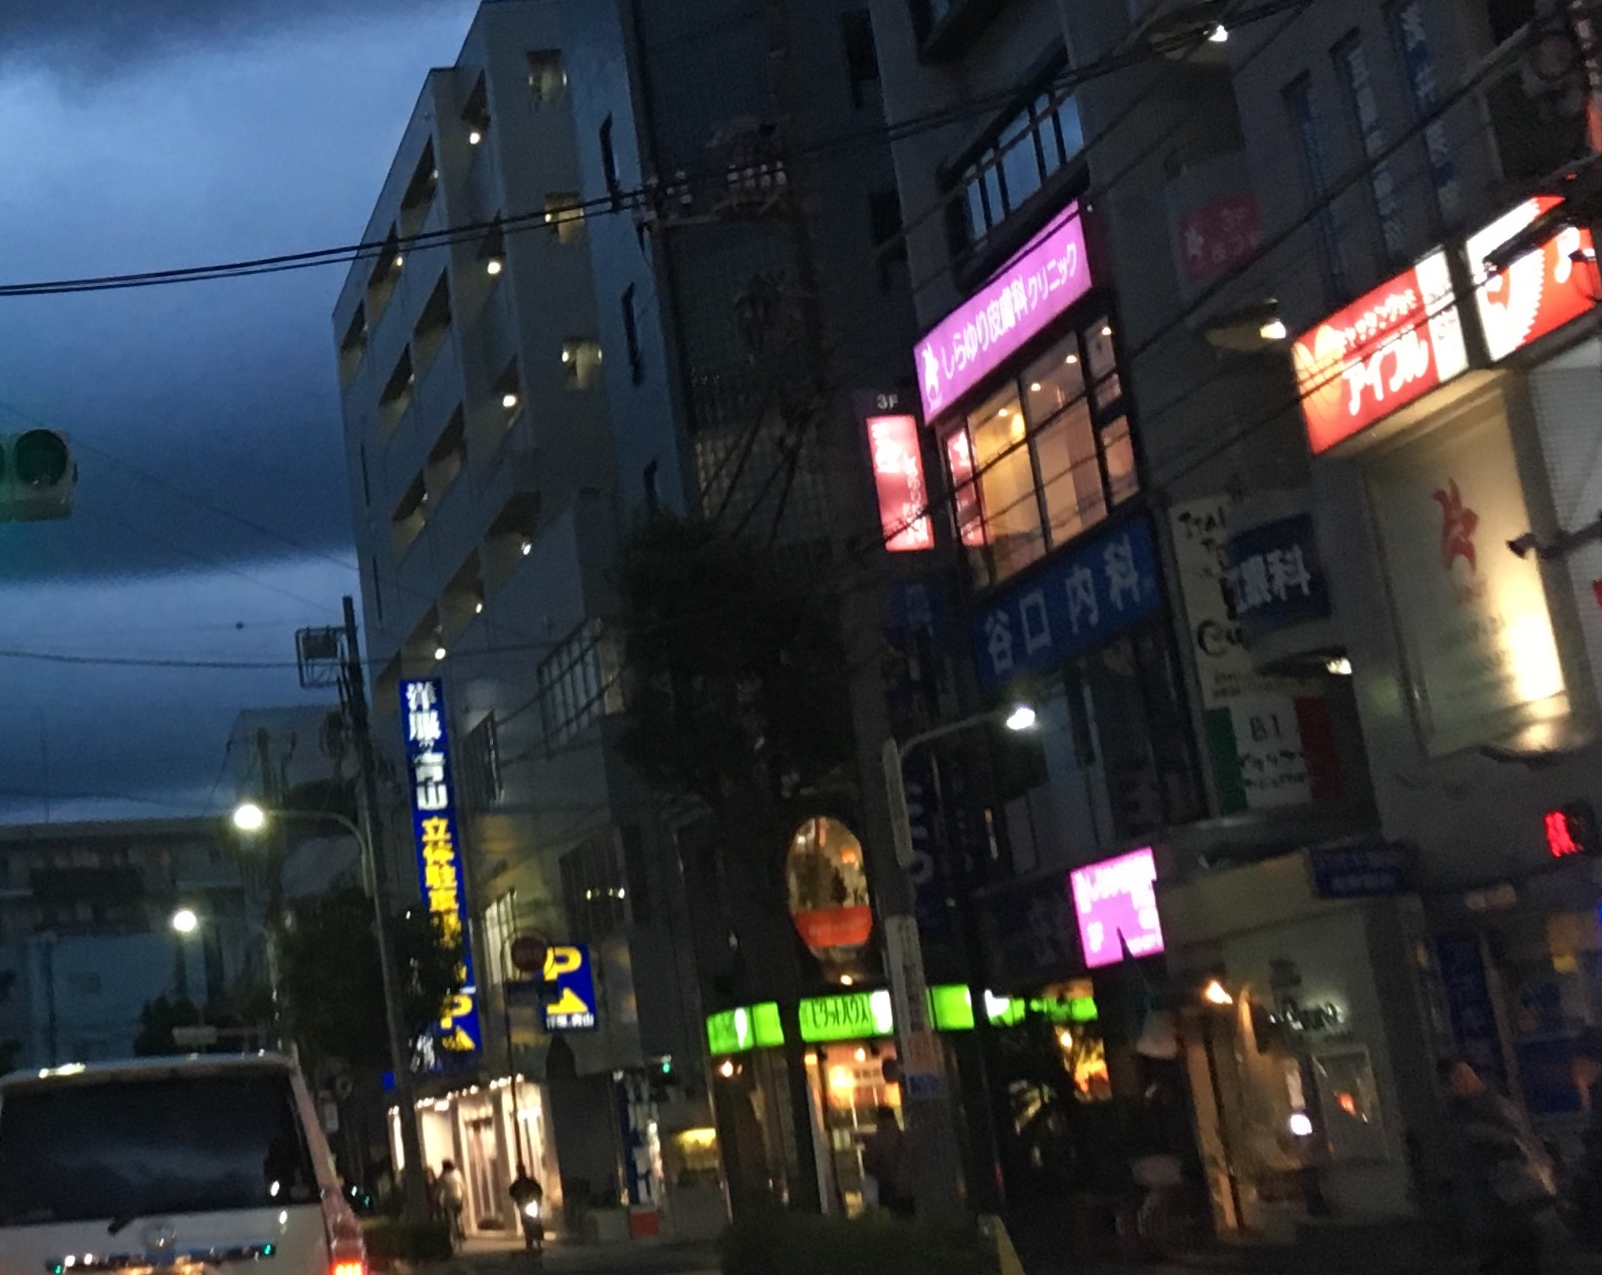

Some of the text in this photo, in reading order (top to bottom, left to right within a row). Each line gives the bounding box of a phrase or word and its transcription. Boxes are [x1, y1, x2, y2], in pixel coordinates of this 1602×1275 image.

[984, 531, 1141, 677] 谷口内科
[543, 946, 583, 982] P
